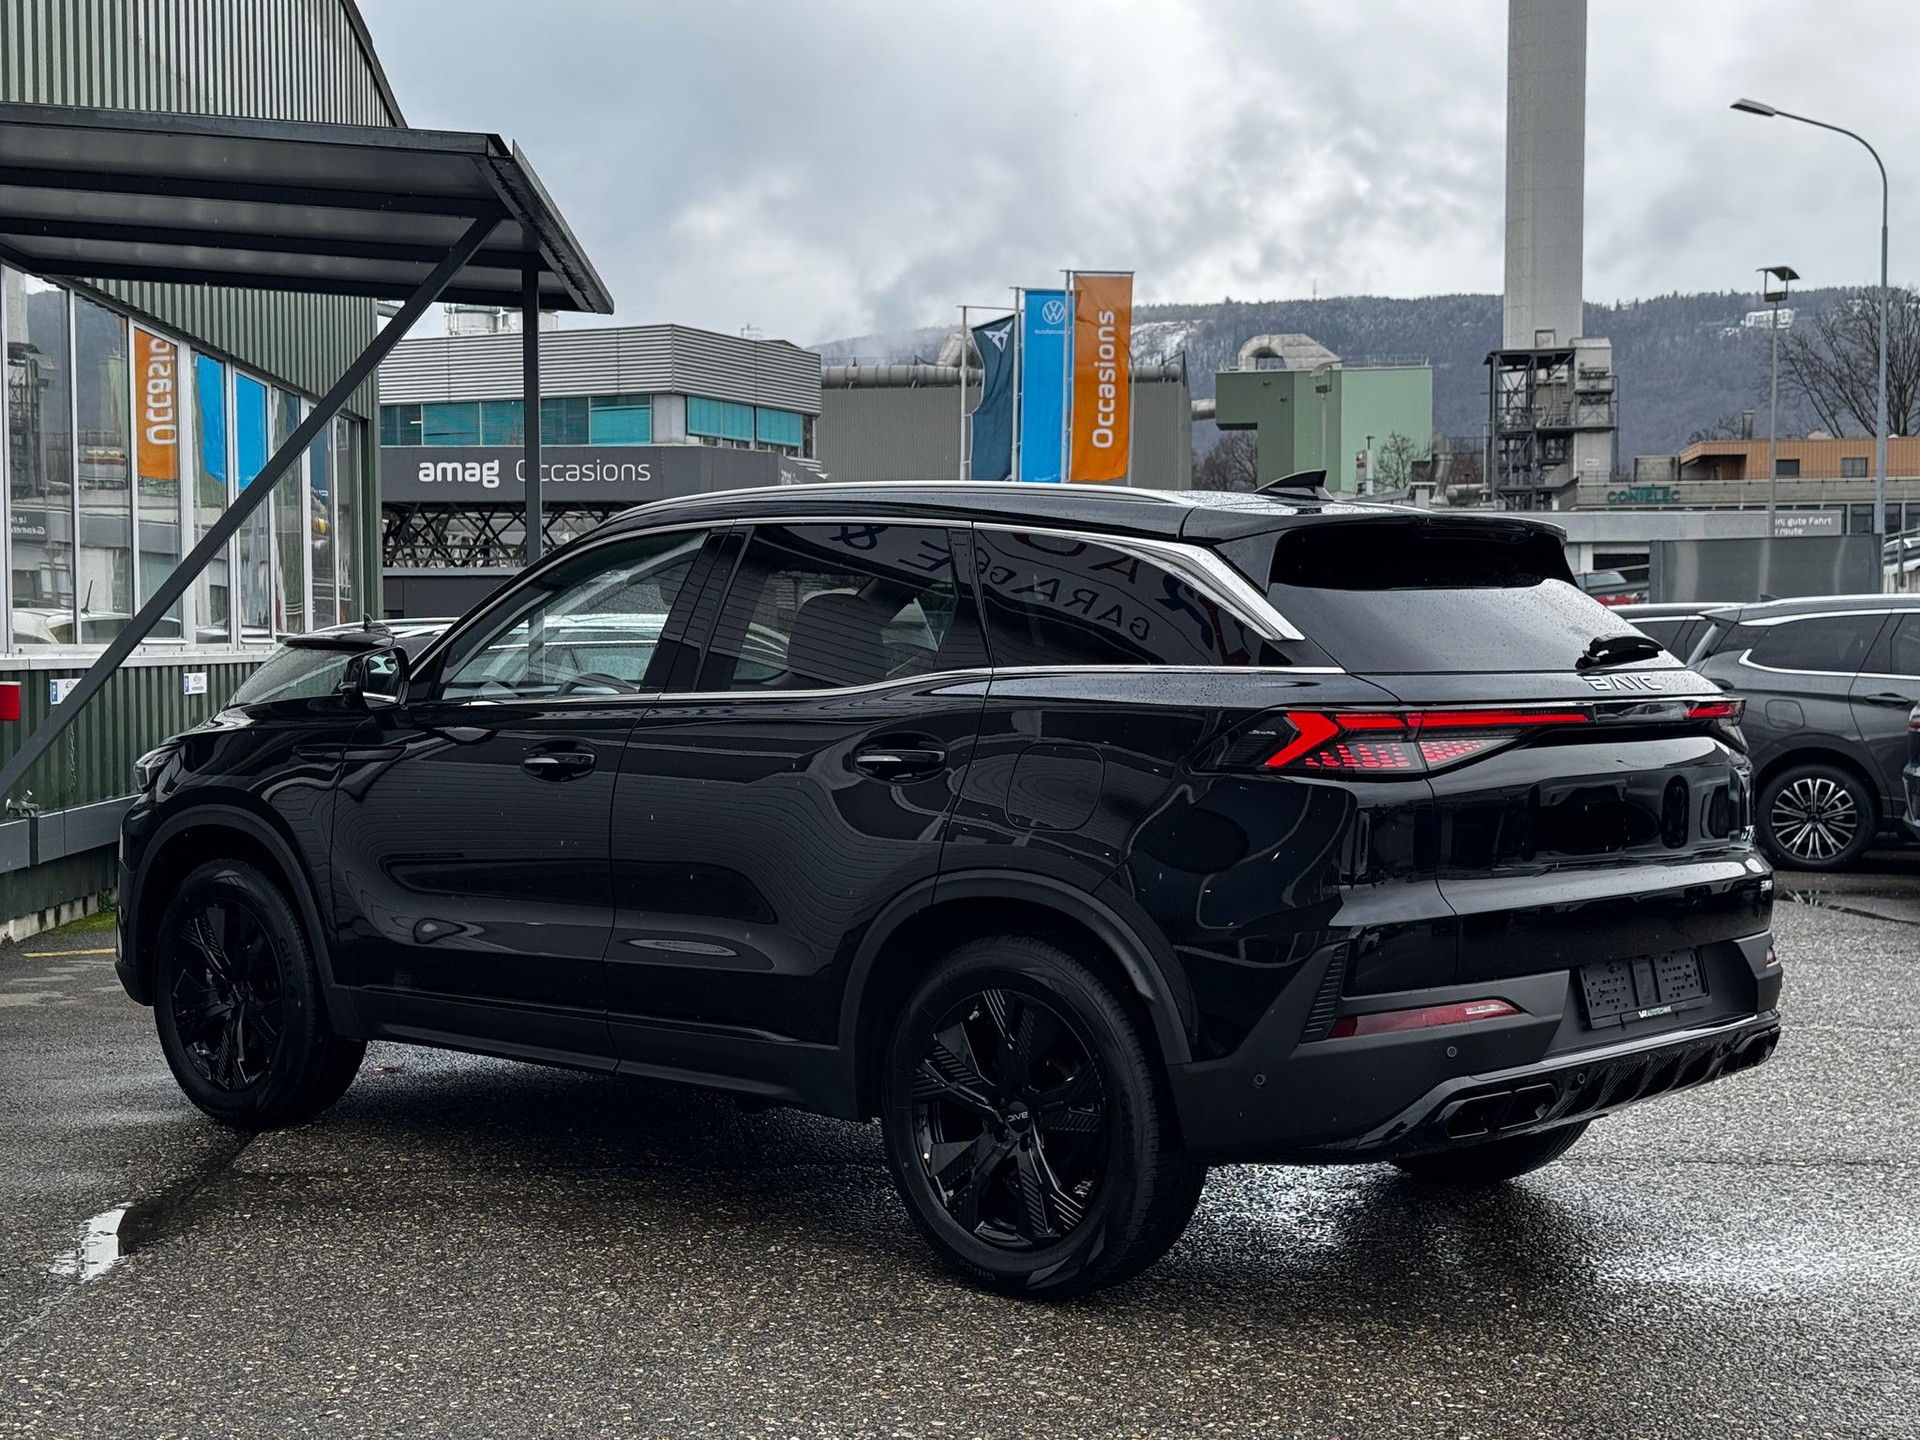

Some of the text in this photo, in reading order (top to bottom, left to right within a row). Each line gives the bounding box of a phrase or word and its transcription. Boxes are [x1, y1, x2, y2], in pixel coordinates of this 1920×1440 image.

[1092, 310, 1116, 449] Occasions
[418, 459, 500, 488] amag
[1808, 516, 1832, 526] Fahrt
[1582, 676, 1662, 691] BAIC
